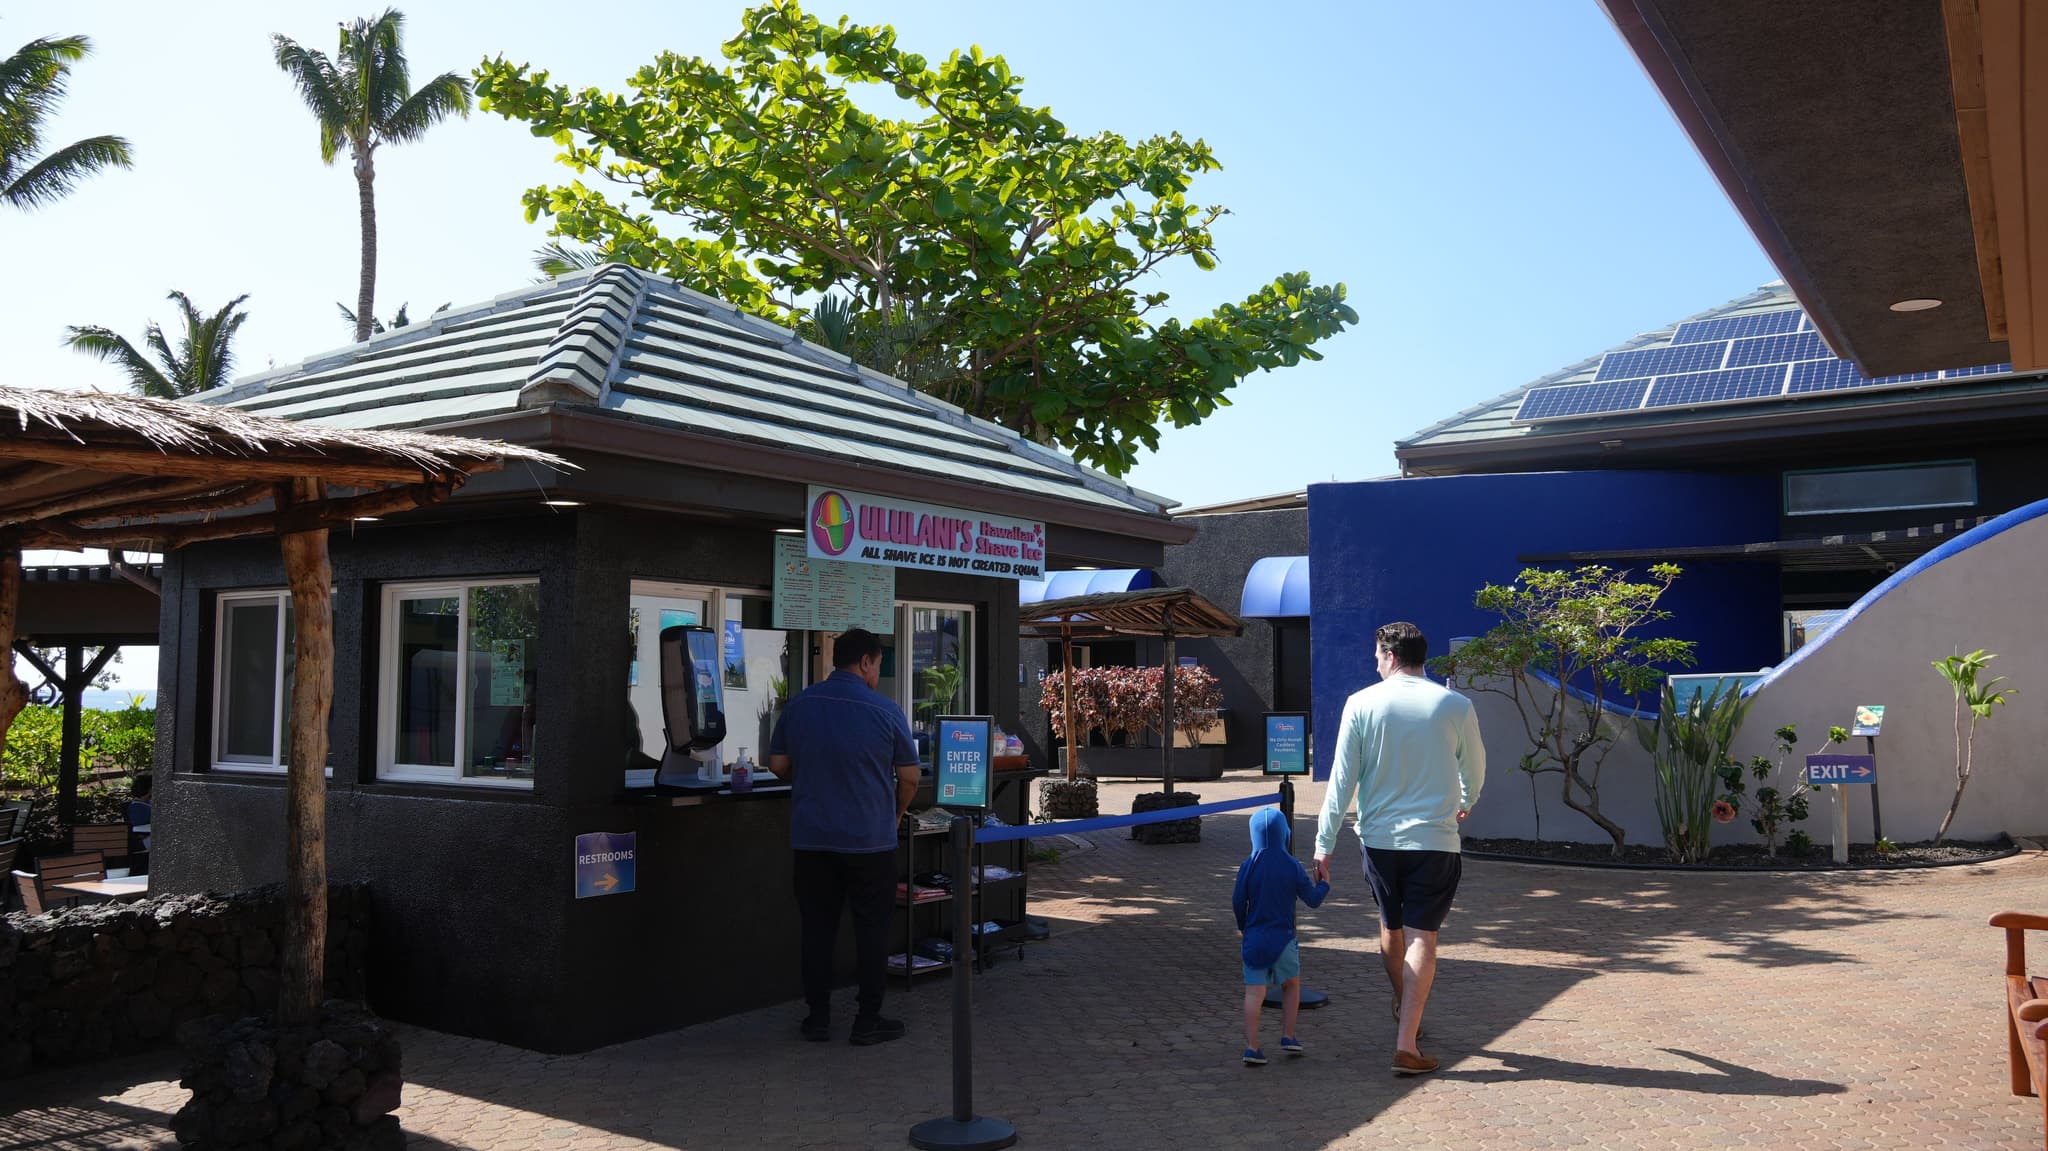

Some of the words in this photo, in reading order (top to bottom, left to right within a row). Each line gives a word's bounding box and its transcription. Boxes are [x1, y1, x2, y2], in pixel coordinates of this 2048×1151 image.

[860, 505, 973, 553] ULULANI'S
[980, 521, 1035, 543] Hawaiian
[976, 537, 1019, 558] Shave
[1022, 543, 1042, 561] Ice
[861, 546, 880, 559] ALL
[883, 548, 917, 563] SHAVE
[919, 553, 935, 565] ICE
[937, 555, 947, 566] IS
[948, 556, 970, 569] NOT
[972, 559, 1011, 573] CREATED
[1013, 564, 1040, 576] EQUAL
[946, 751, 981, 761] ENTER
[950, 763, 977, 773] HERE
[1810, 765, 1849, 778] EXIT
[579, 850, 634, 864] RESTROOMS
